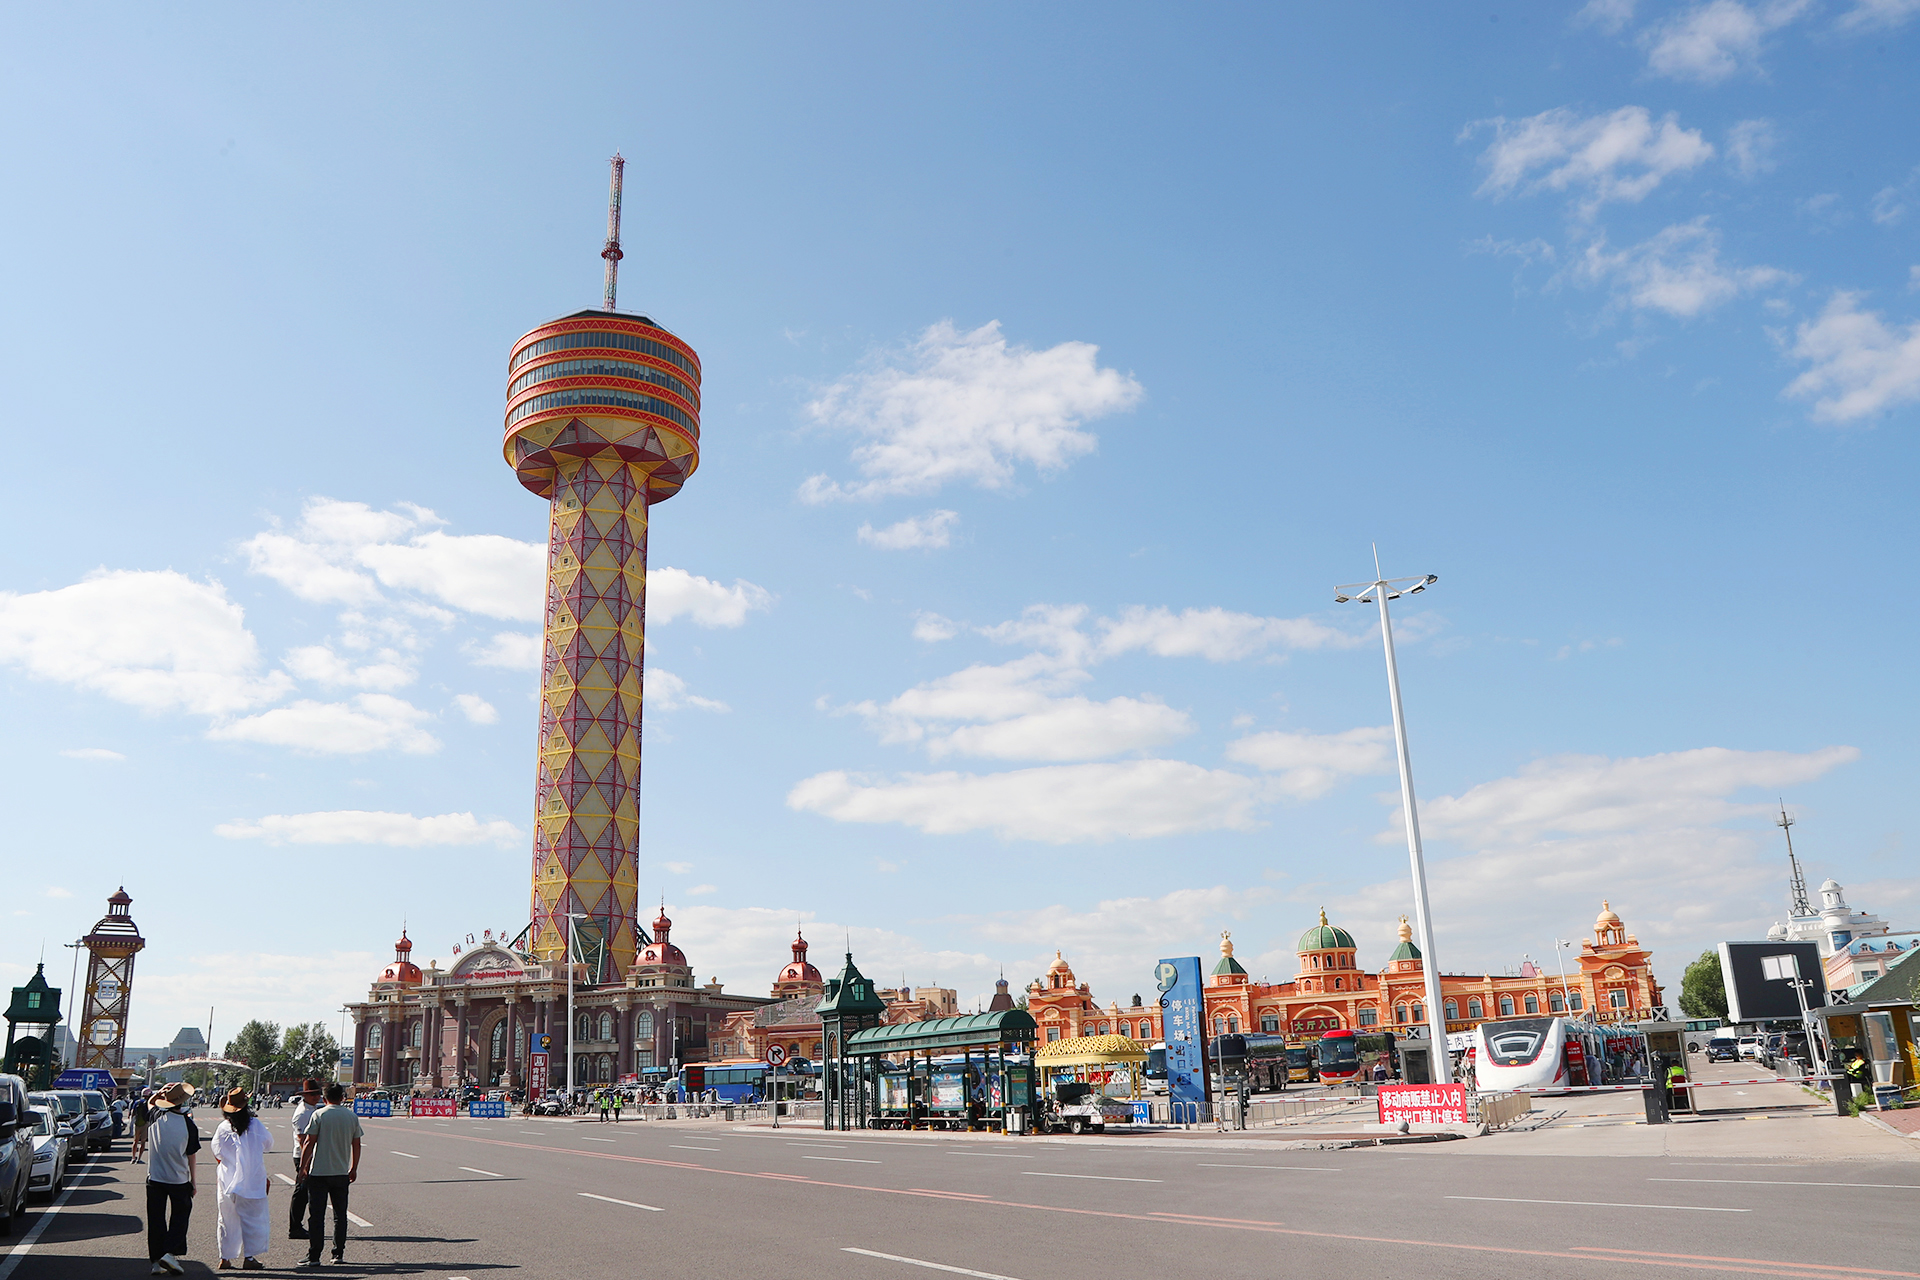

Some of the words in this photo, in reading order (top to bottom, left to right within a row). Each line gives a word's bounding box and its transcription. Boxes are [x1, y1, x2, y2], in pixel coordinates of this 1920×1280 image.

[506, 969, 524, 977] Tower
[1294, 1018, 1339, 1031] 大厅入口
[86, 1074, 94, 1088] P
[1381, 1089, 1461, 1108] 移动商贩禁止入内
[356, 1107, 388, 1115] 禁止停车
[414, 1107, 453, 1115] 禁止入内
[472, 1108, 502, 1116] 禁止停车
[1383, 1109, 1464, 1124] 车场出口禁止停车
